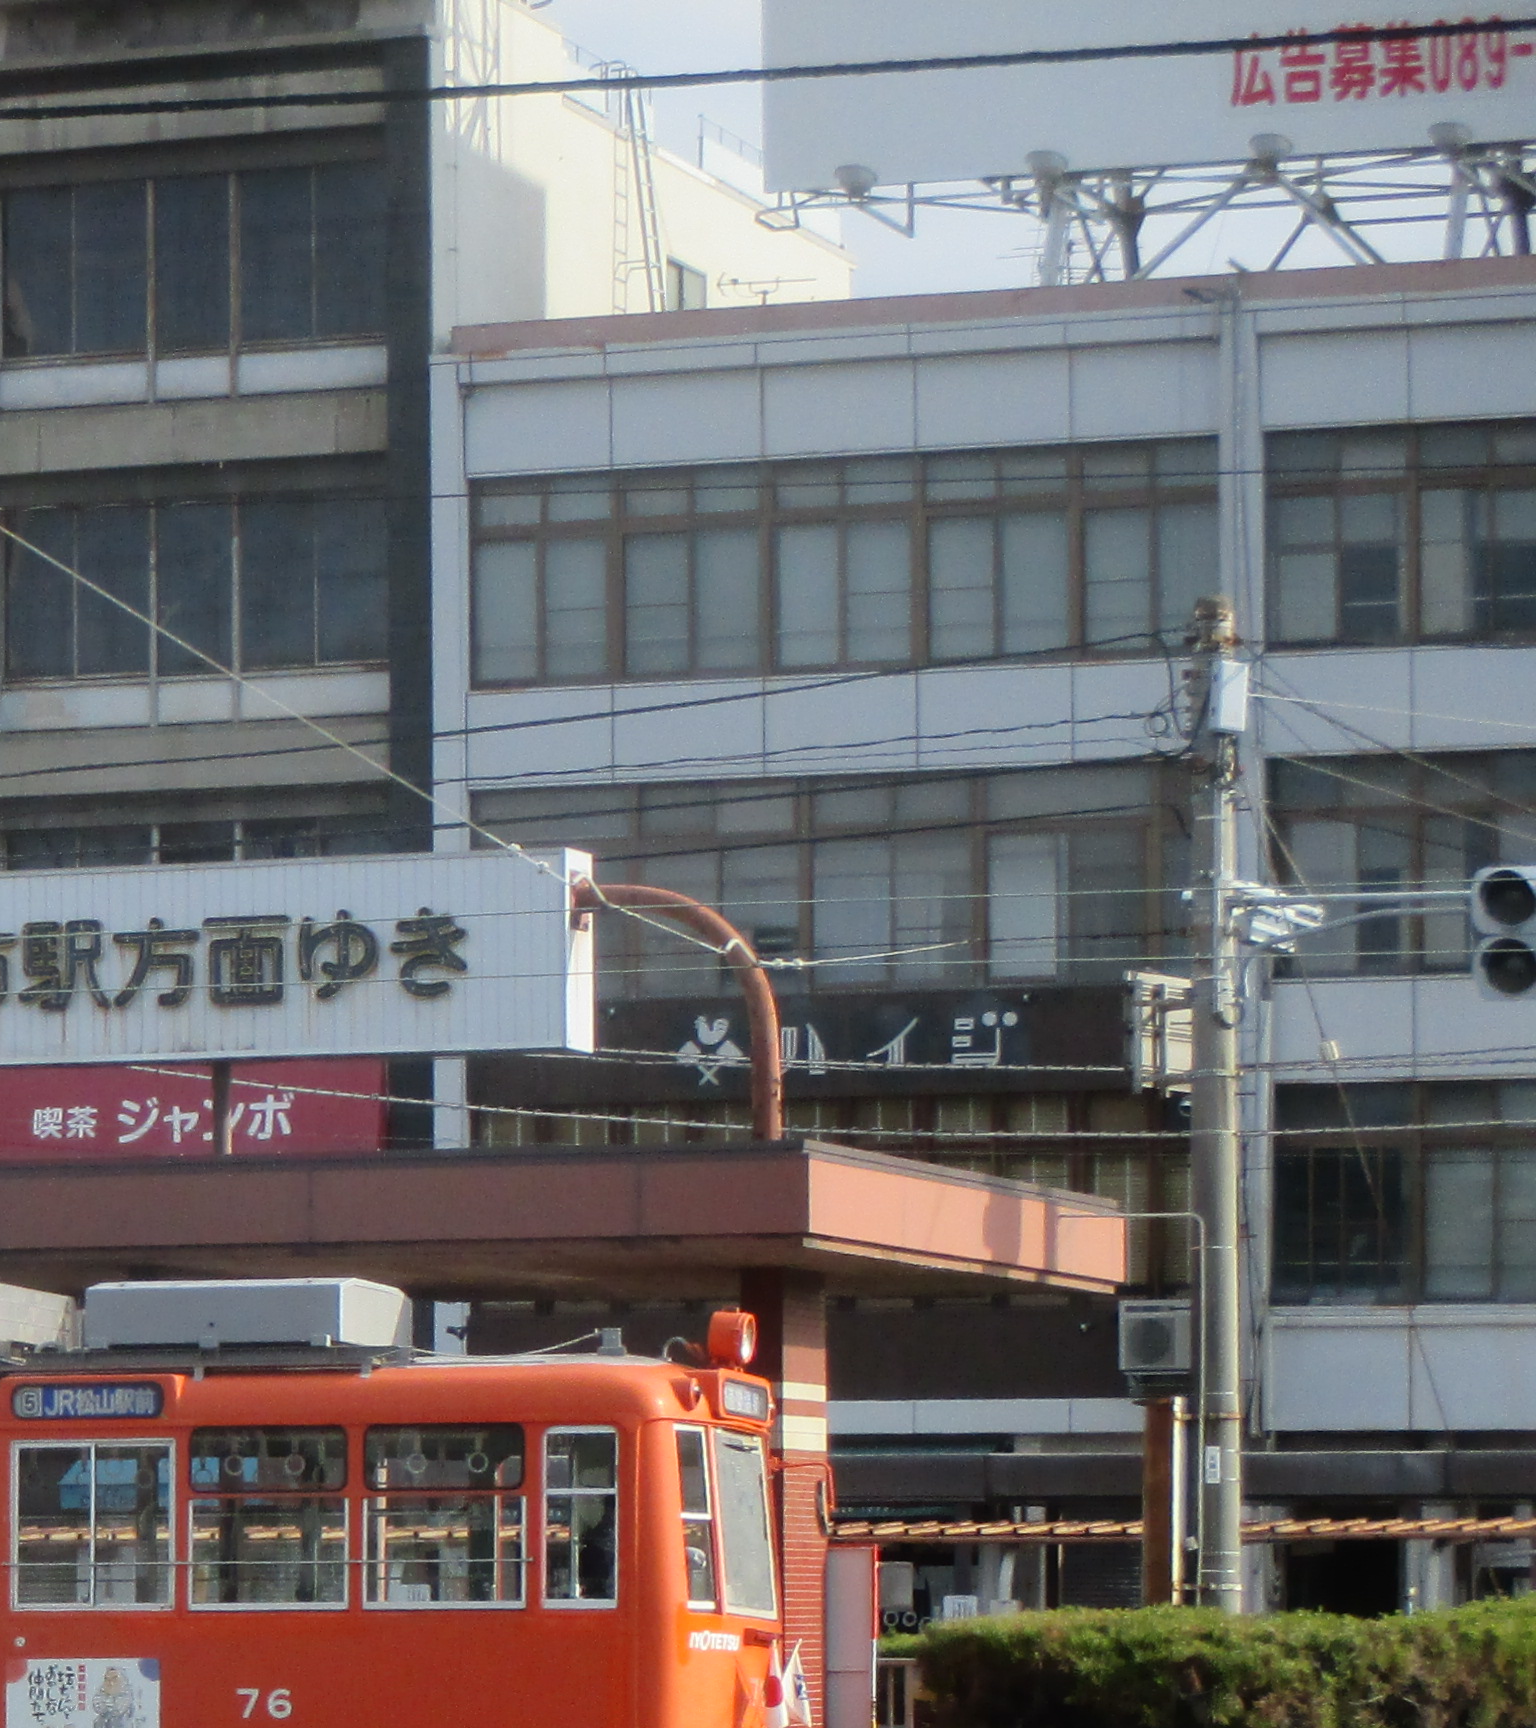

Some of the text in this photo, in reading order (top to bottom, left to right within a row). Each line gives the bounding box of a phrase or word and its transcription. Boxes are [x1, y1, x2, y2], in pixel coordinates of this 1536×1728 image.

[33, 1106, 98, 1139] 喫茶
[689, 1629, 741, 1651] IYOTETSU
[236, 1688, 292, 1718] 76
